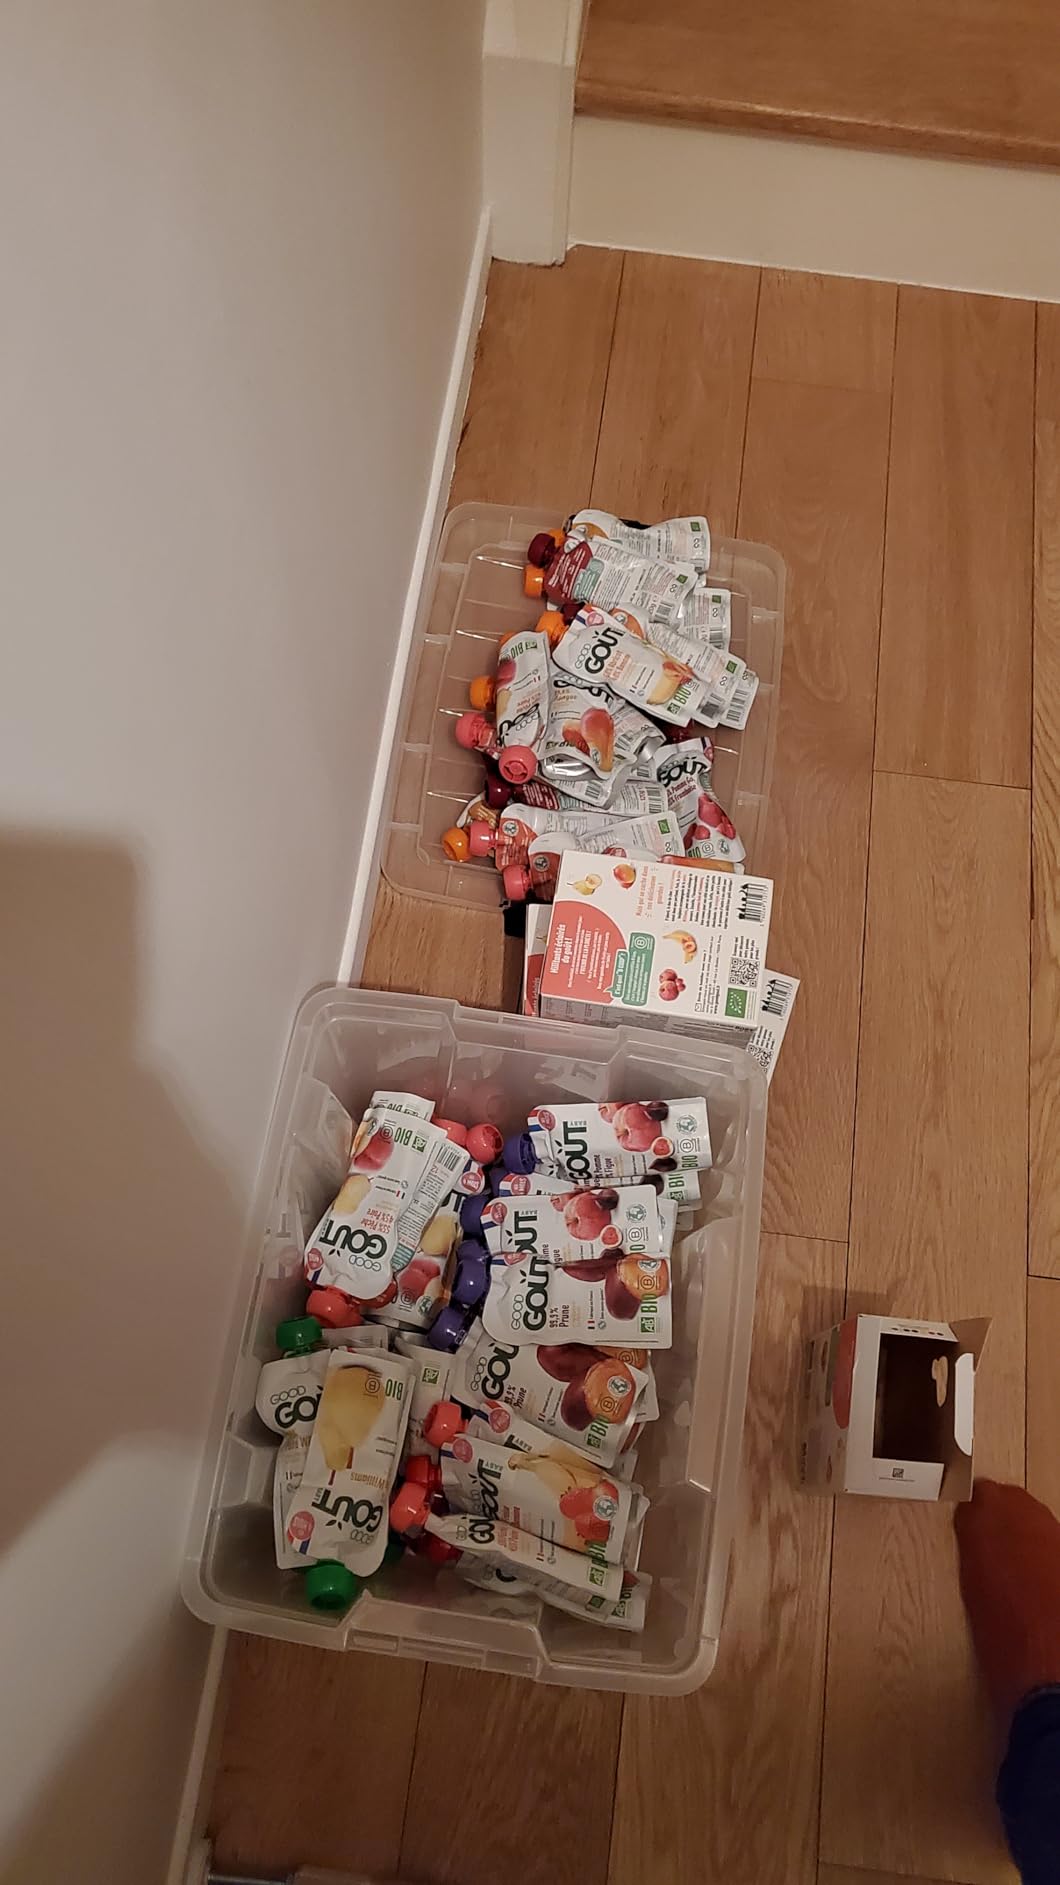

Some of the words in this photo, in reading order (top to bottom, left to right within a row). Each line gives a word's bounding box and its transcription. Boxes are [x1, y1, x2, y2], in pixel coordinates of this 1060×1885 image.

[574, 643, 592, 669] GOOD
[393, 1126, 412, 1145] BIO
[681, 1155, 698, 1167] BIO
[318, 1219, 386, 1259] GOÛT
[348, 1254, 380, 1272] GOOD
[519, 1254, 549, 1330] GOÛT
[640, 1293, 657, 1313] BIO
[510, 1293, 523, 1330] GOOD
[549, 1307, 559, 1327] 99,9%
[558, 1303, 570, 1328] Prune
[470, 1355, 486, 1390] GOOD
[270, 1385, 305, 1405] GOOD
[385, 1378, 402, 1400] BIO
[349, 1471, 385, 1489] Williams
[311, 1488, 382, 1532] GOÛT
